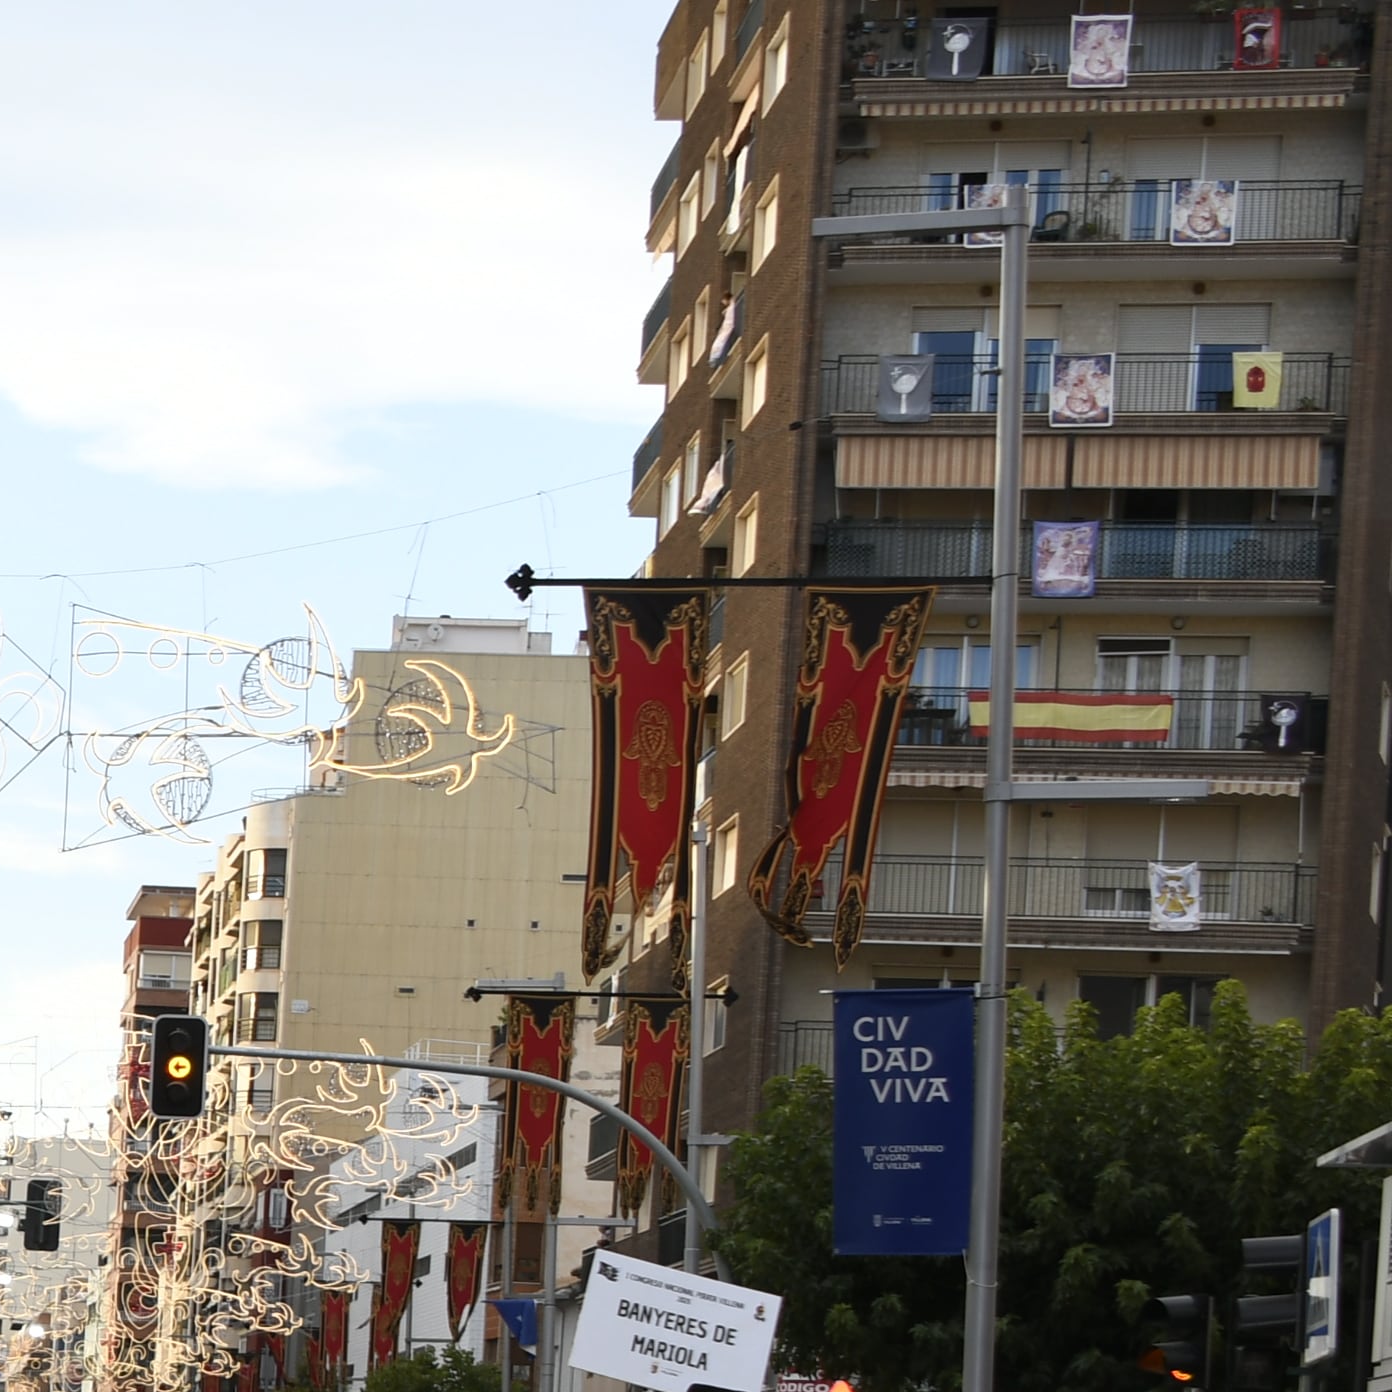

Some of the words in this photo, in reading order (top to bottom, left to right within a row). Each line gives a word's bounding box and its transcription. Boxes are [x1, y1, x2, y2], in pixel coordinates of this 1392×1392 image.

[853, 1016, 909, 1042] CIV
[861, 1047, 933, 1073] DAD
[870, 1077, 950, 1103] VIVA
[617, 1299, 708, 1339] BANYERES
[712, 1324, 738, 1346] DE
[631, 1334, 708, 1371] MARIOLA
